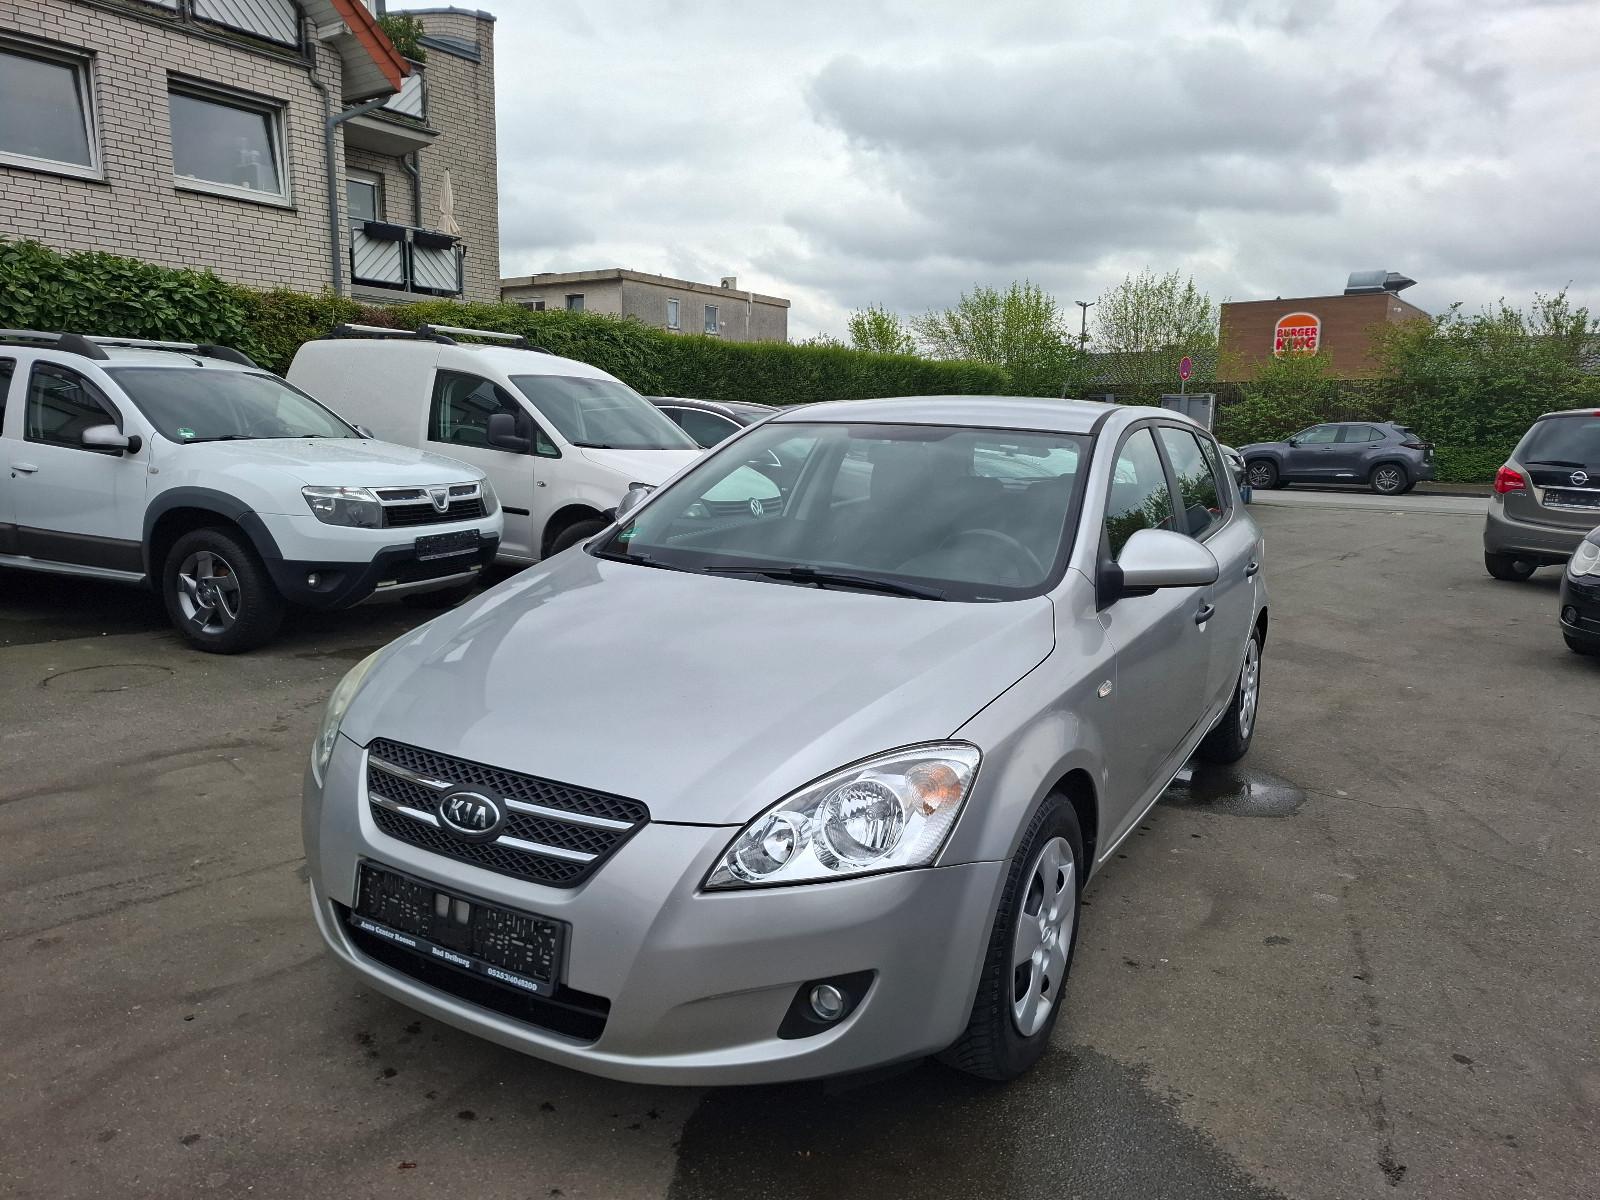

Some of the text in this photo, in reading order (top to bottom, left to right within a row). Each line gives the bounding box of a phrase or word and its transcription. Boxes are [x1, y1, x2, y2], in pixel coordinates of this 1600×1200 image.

[1277, 327, 1317, 337] BURGER
[1276, 336, 1316, 350] KNG
[448, 798, 486, 828] KIA
[432, 946, 470, 968] Bad Driburg
